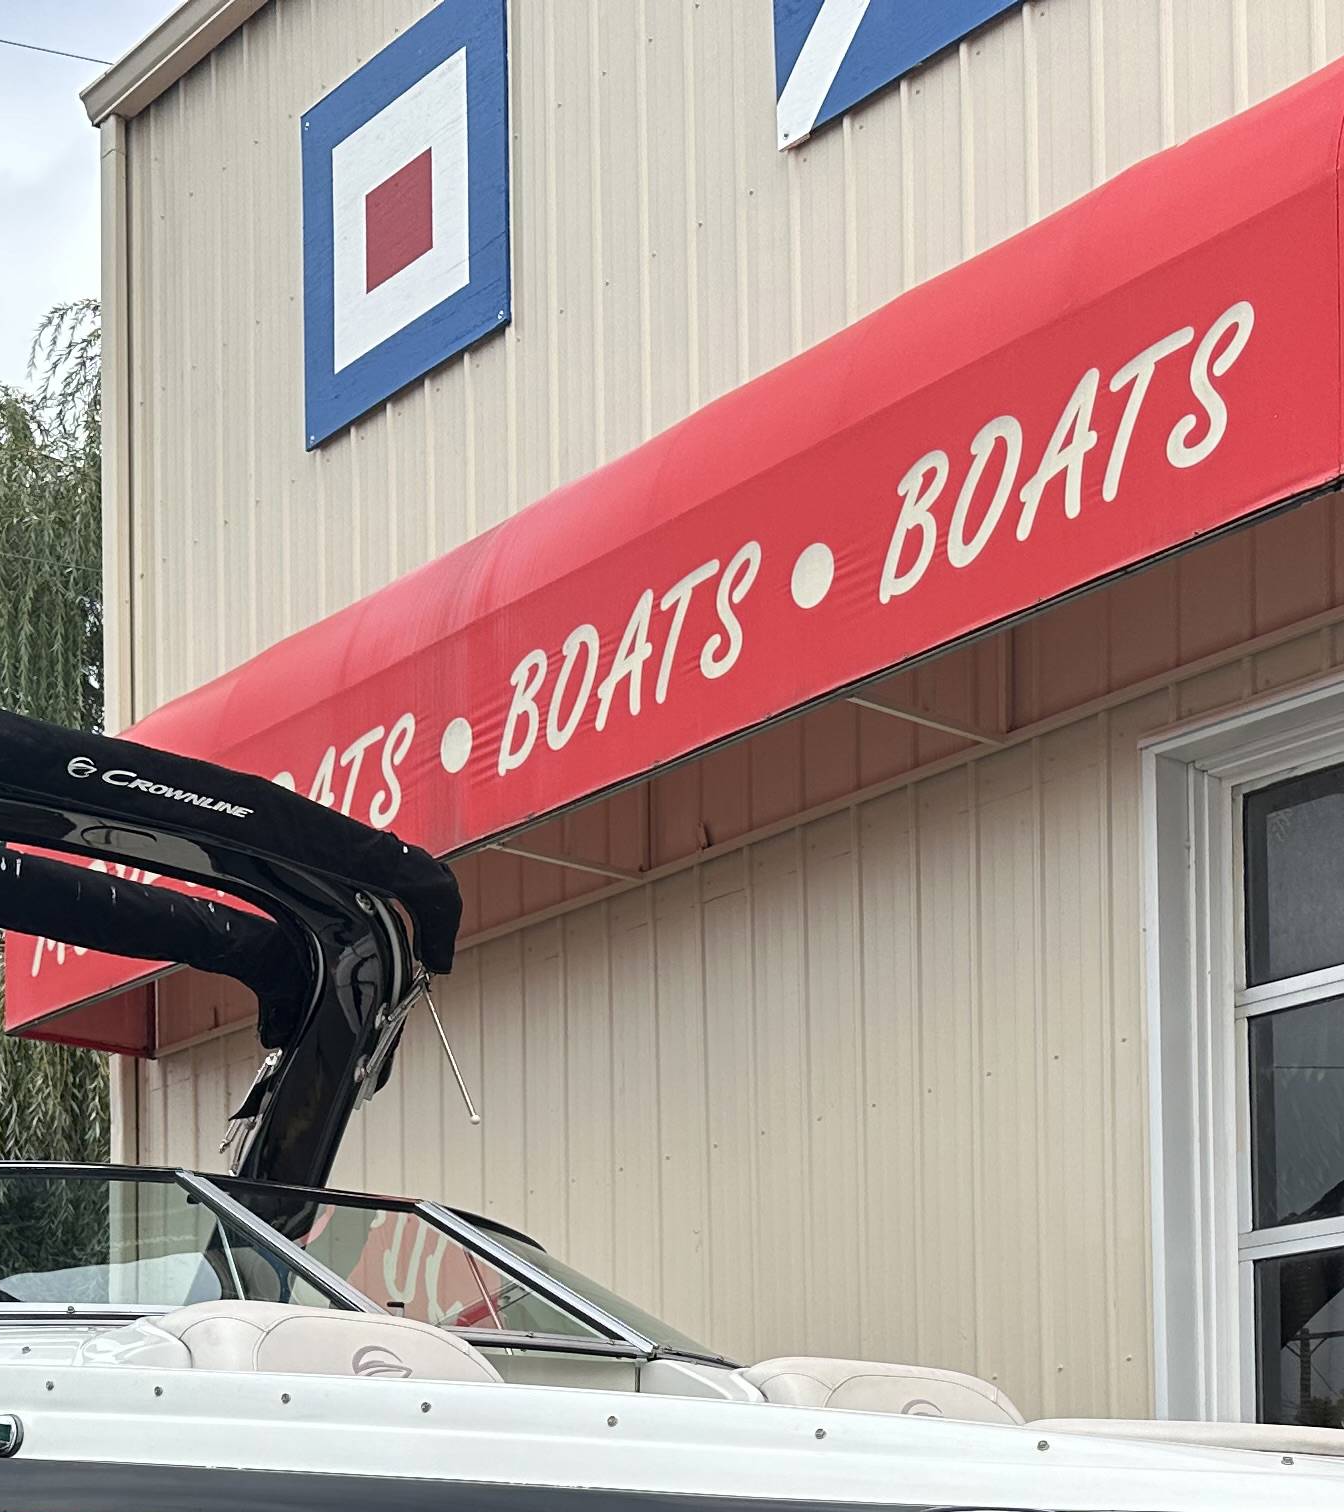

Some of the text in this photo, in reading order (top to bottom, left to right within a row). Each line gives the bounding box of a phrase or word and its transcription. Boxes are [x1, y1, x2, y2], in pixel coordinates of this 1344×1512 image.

[271, 301, 1254, 829] ATS BOATS BOATS
